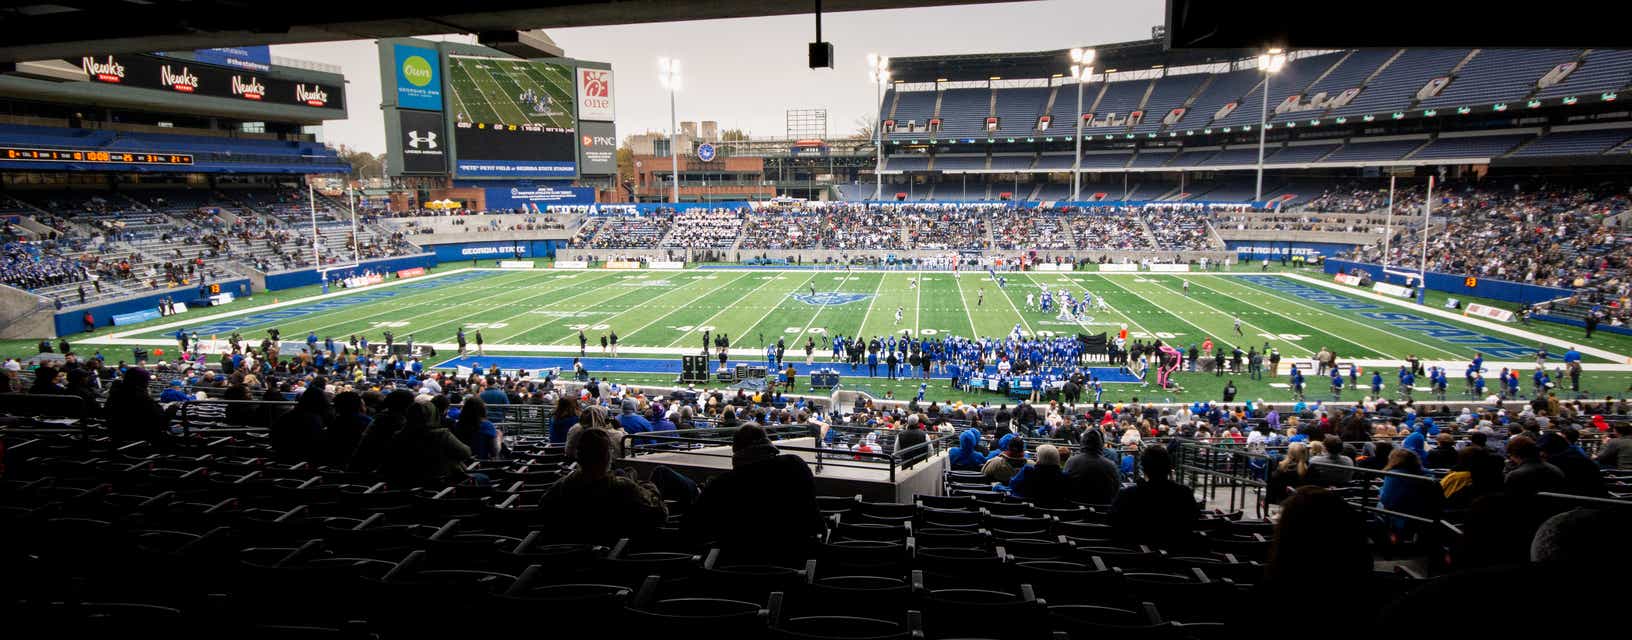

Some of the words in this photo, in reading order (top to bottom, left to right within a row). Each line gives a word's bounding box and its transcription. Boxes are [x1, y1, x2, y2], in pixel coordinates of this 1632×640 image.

[82, 55, 125, 78] Newk's
[405, 65, 429, 78] Own
[161, 64, 199, 87] Newk's
[232, 75, 265, 96] Newk's
[296, 84, 328, 103] Newk's
[584, 99, 609, 109] one
[593, 136, 615, 146] PNC
[462, 247, 498, 255] GEORGIA
[1237, 246, 1280, 254] GEORGIA
